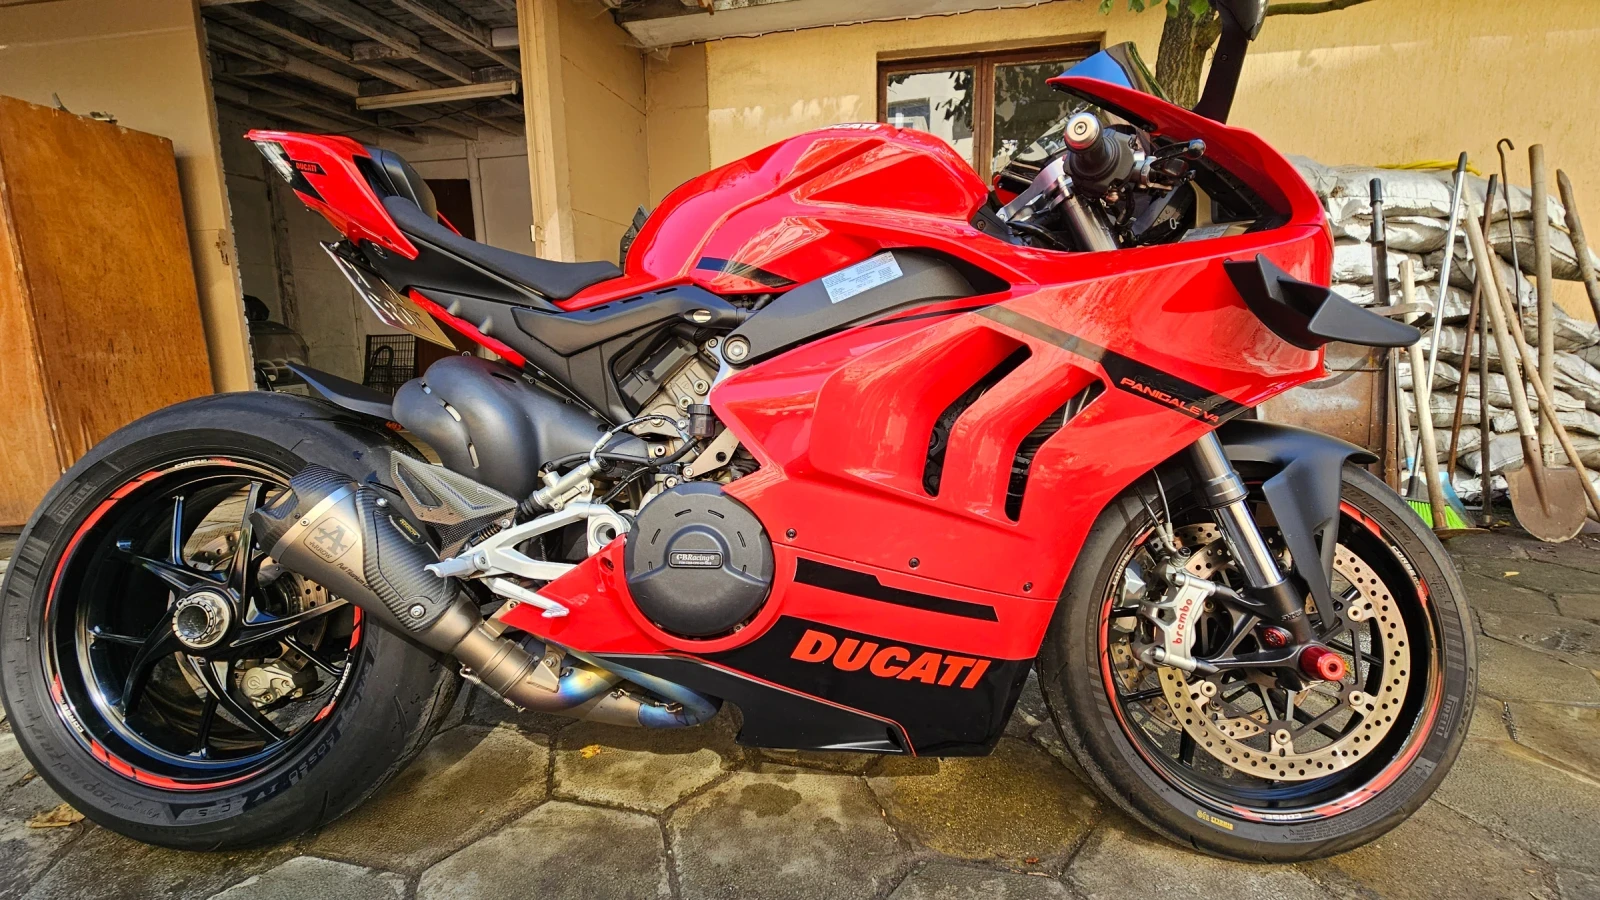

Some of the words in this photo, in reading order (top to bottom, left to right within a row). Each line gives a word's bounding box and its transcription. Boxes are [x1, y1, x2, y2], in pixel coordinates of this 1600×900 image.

[295, 162, 317, 172] DUCATI
[1120, 377, 1202, 416] PANIGALE
[1203, 410, 1220, 423] V4
[309, 541, 333, 560] ARROW
[1391, 545, 1417, 576] CORSE
[1172, 598, 1193, 646] brembo
[790, 629, 991, 689] DUCATI
[333, 662, 351, 697] CORSE
[62, 700, 84, 733] CORSE
[1435, 694, 1460, 738] PIRELLI
